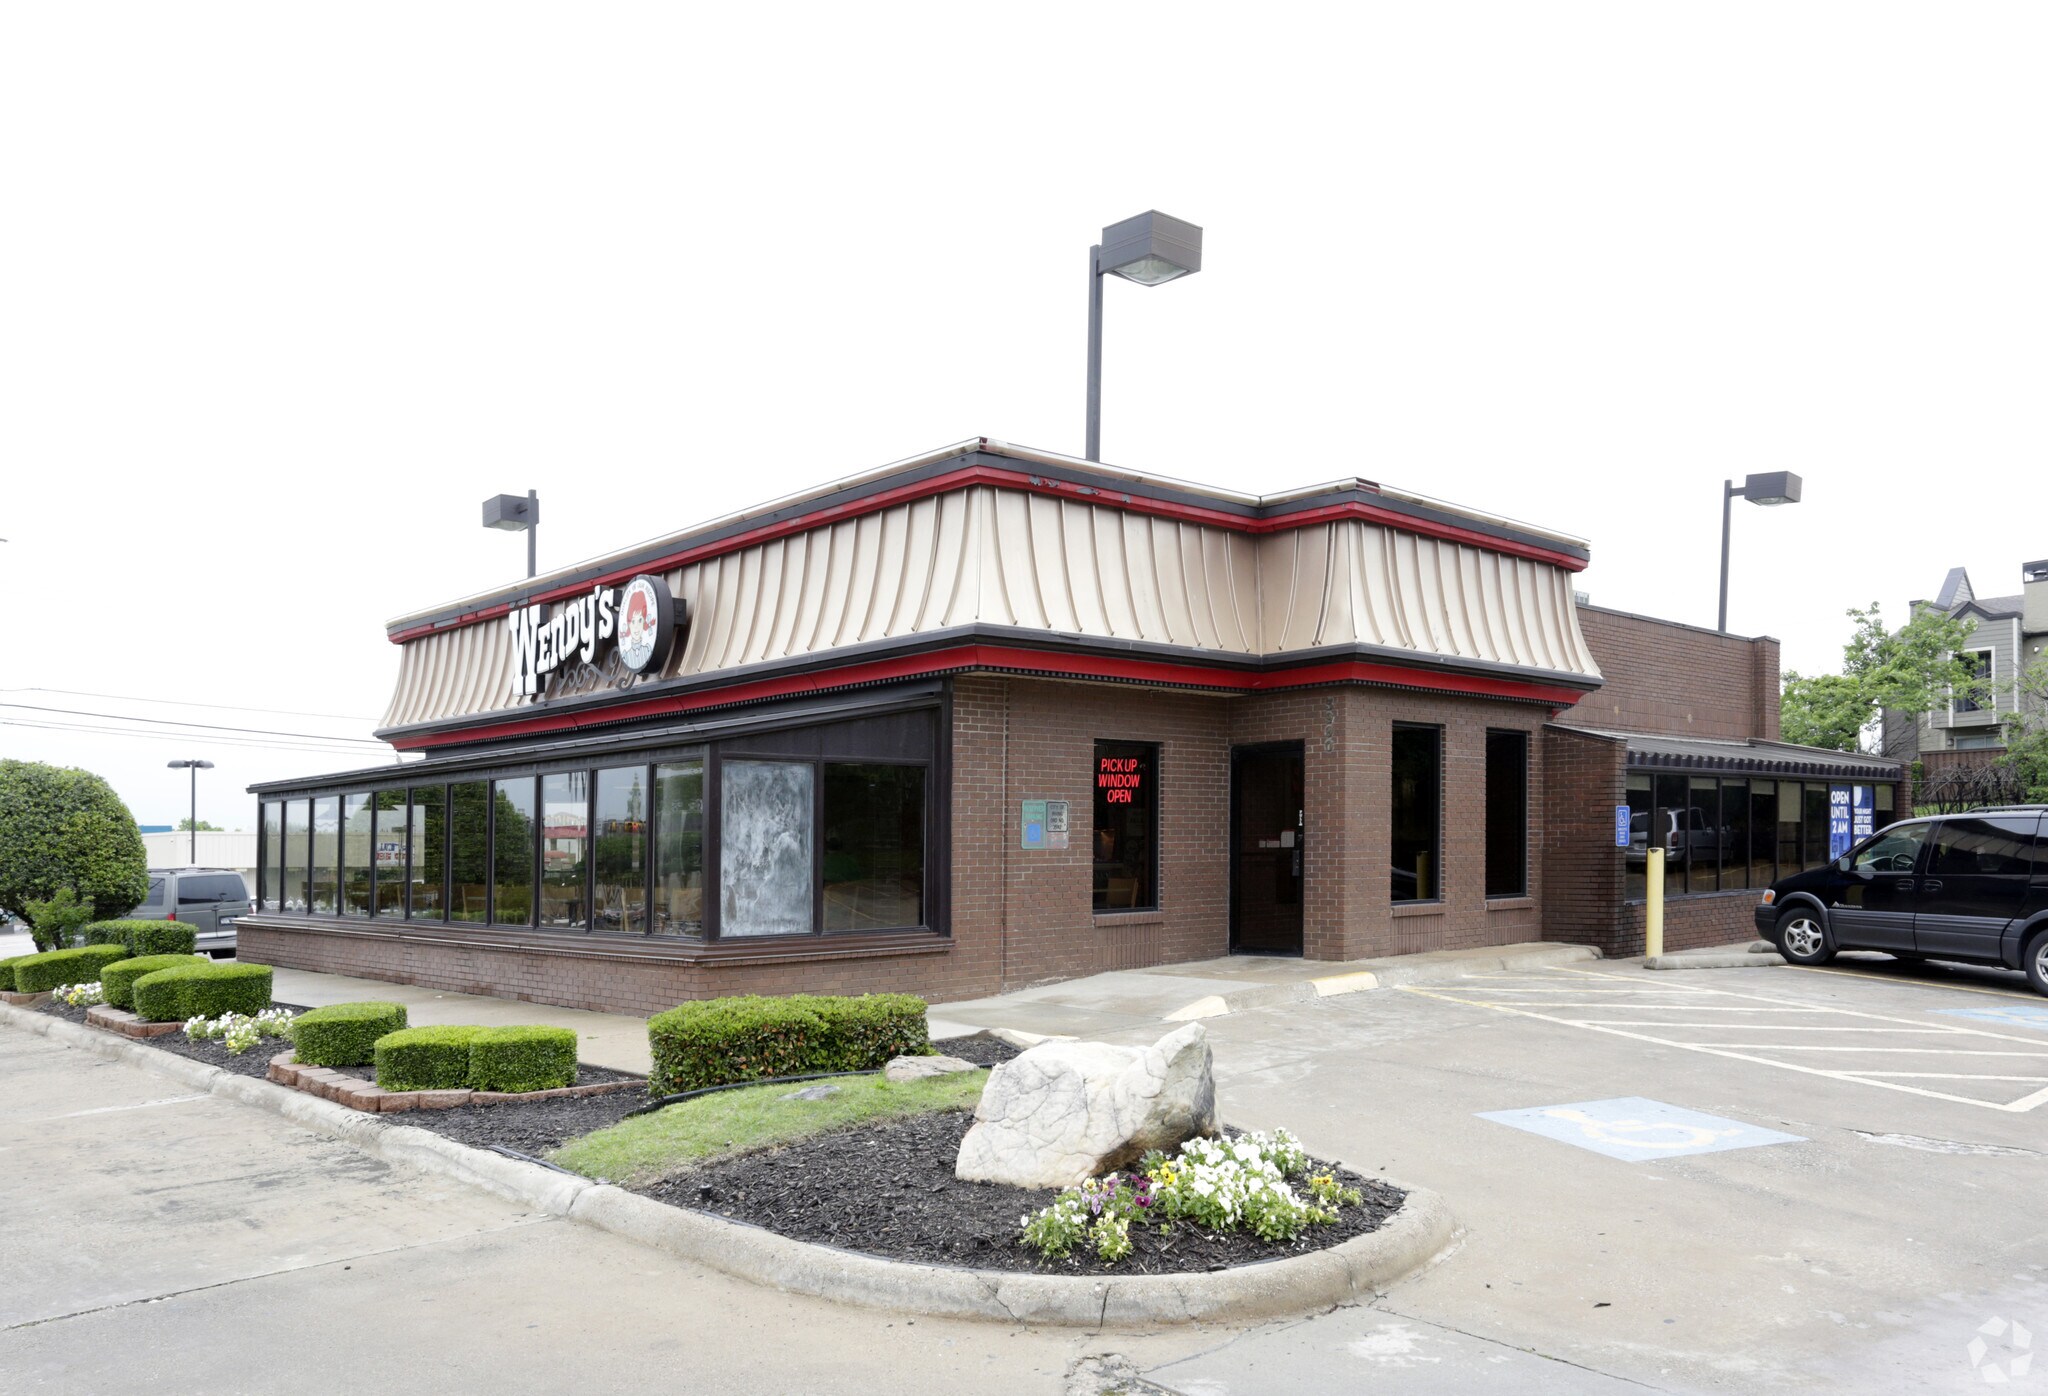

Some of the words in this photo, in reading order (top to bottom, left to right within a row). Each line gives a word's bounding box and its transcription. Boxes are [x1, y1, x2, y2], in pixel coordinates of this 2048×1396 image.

[1098, 774, 1140, 787] WINDOW
[1107, 789, 1132, 803] OPEN
[1831, 791, 1850, 804] OPEN
[1831, 806, 1849, 819] UNTIL
[1832, 821, 1837, 834] 2
[1838, 821, 1848, 834] AM
